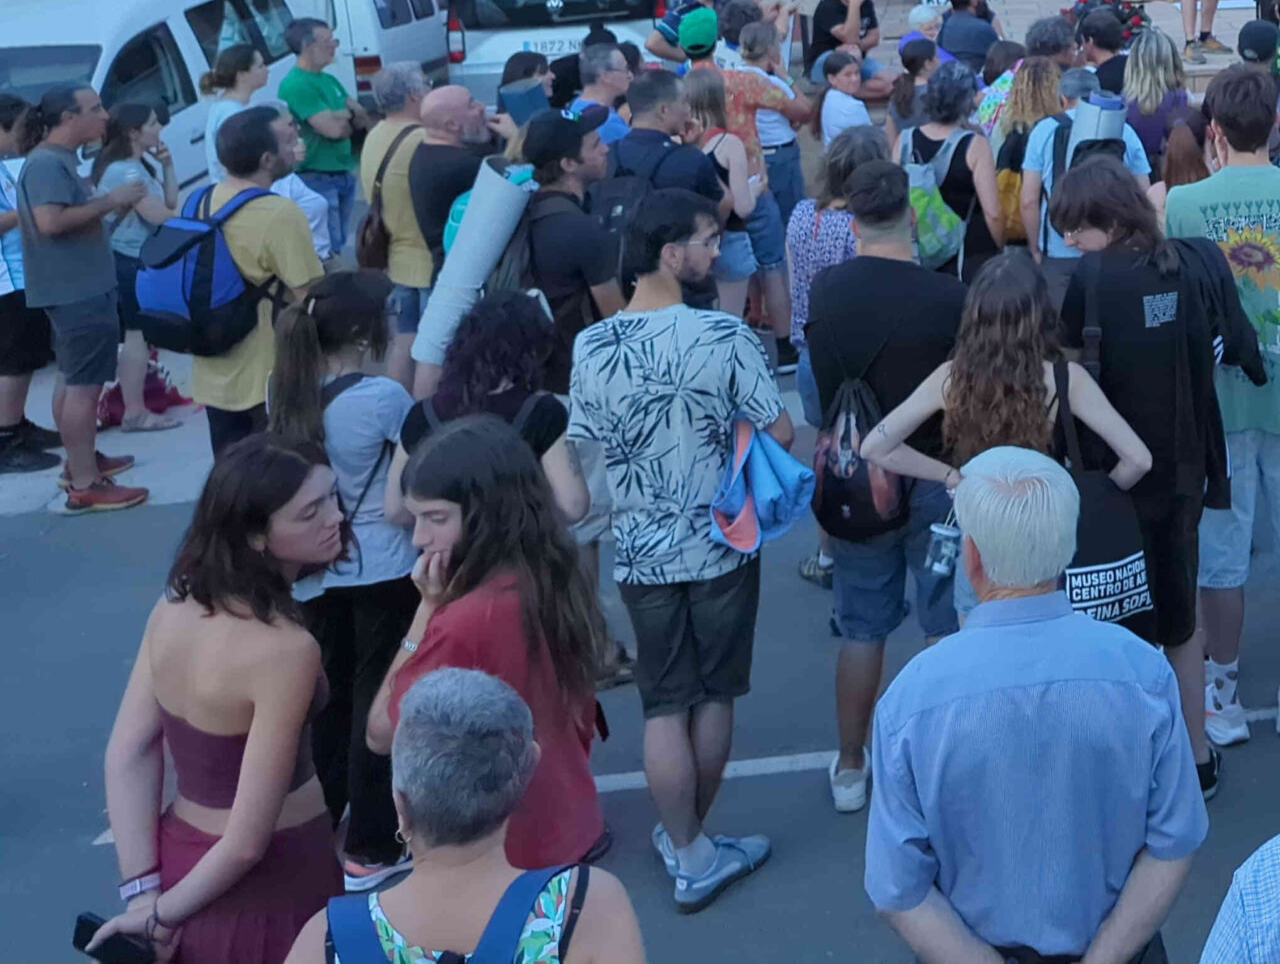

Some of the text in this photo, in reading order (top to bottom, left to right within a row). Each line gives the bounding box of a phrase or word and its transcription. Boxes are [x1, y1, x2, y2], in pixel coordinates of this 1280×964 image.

[534, 39, 565, 53] 1872
[1071, 570, 1115, 589] MUSEO
[1072, 580, 1121, 602] CENTRO
[1122, 576, 1135, 592] DE
